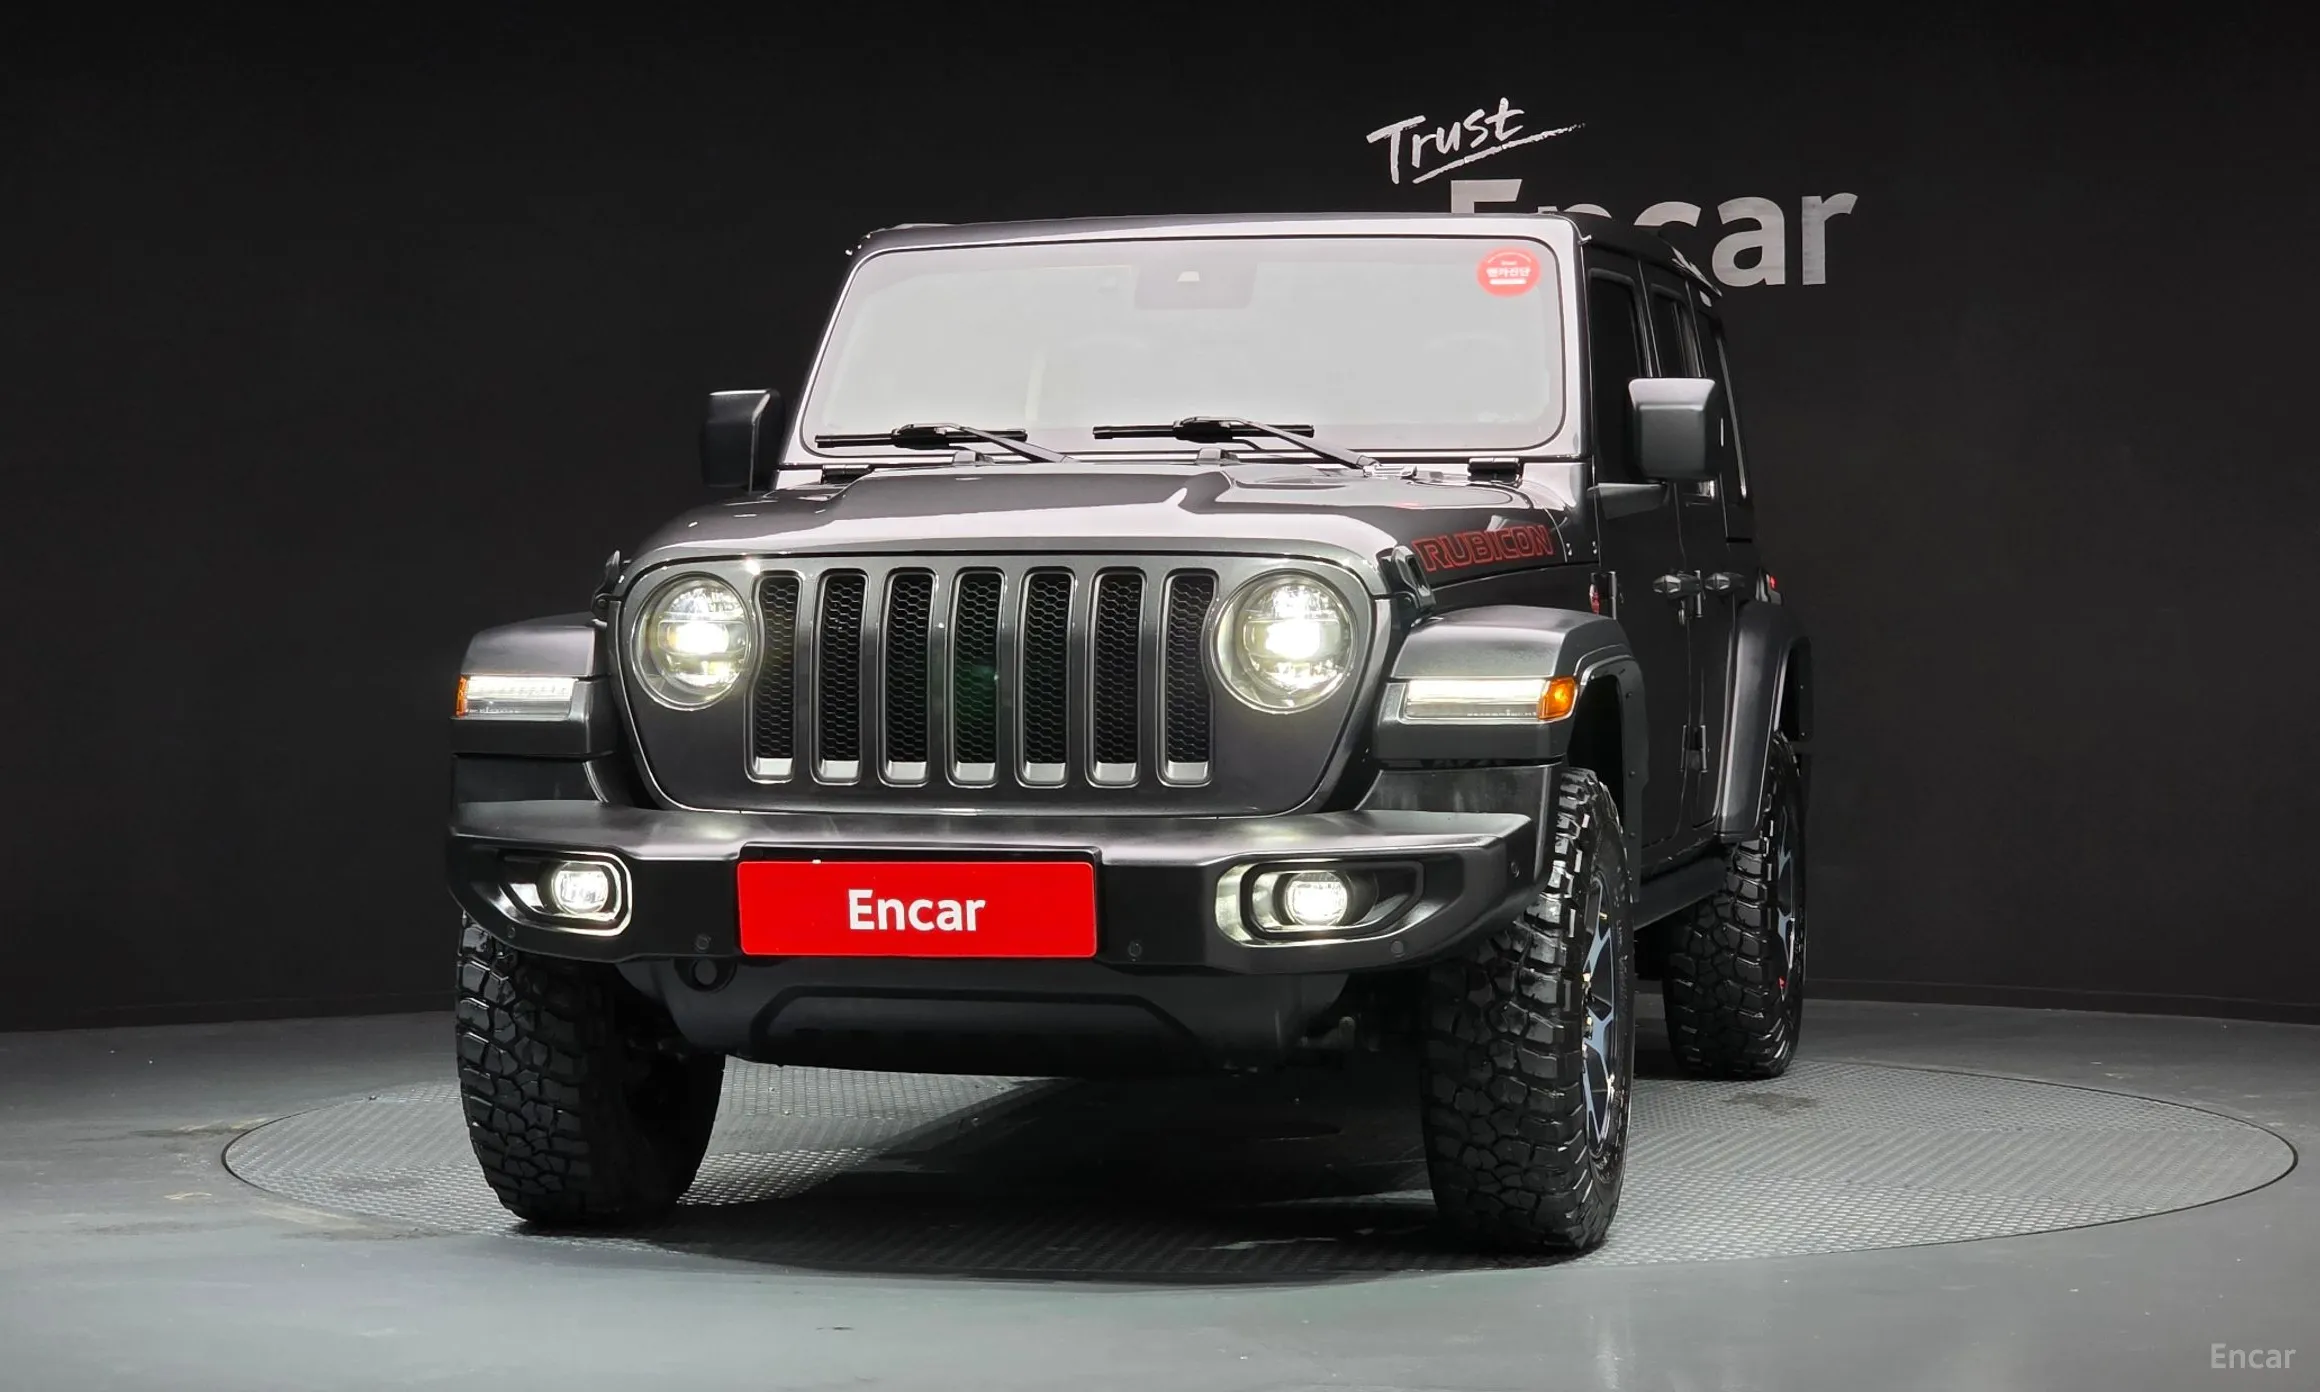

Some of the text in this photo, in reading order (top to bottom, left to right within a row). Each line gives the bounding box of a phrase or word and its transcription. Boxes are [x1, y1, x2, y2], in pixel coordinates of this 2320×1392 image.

[1366, 97, 1525, 184] Trust
[1411, 524, 1555, 572] RUBICON
[848, 888, 986, 932] Encar
